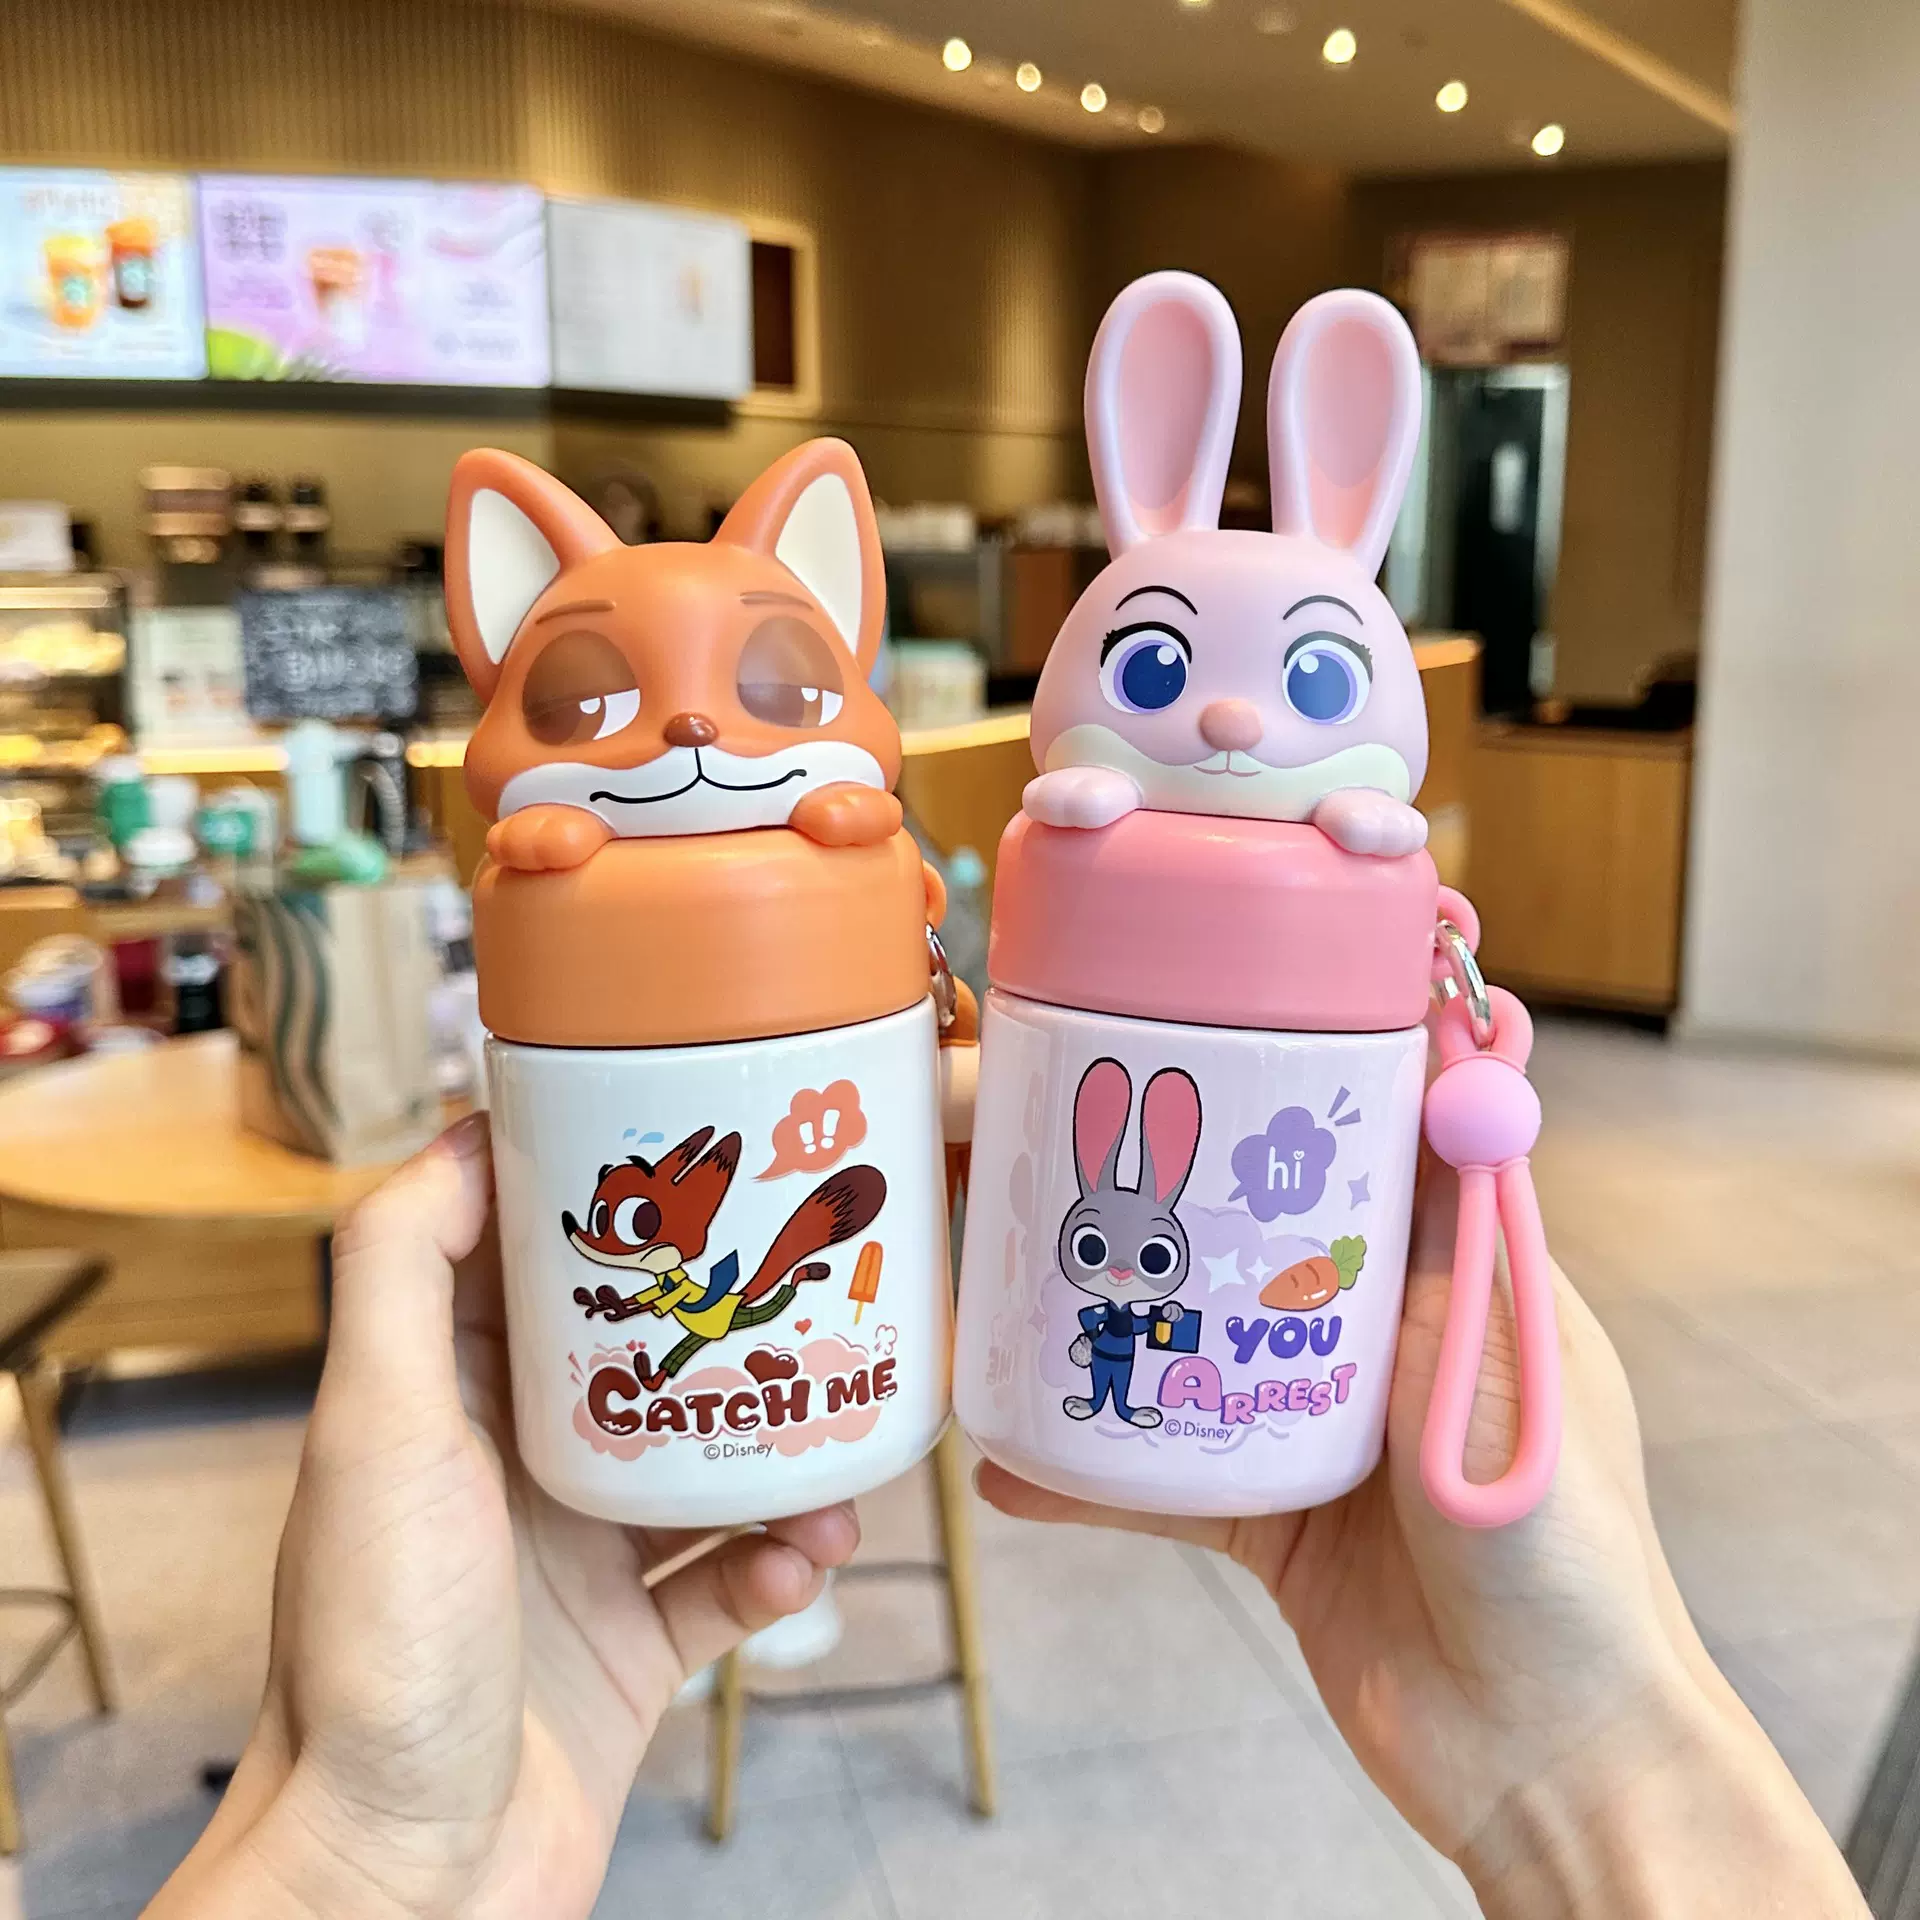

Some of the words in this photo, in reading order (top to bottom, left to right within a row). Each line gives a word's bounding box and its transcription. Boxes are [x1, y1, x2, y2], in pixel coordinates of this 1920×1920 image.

[1266, 1146, 1306, 1192] hi
[1225, 1315, 1343, 1364] YOU
[587, 1365, 811, 1436] CATCH
[826, 1356, 898, 1412] ME
[1157, 1355, 1357, 1425] ARREST
